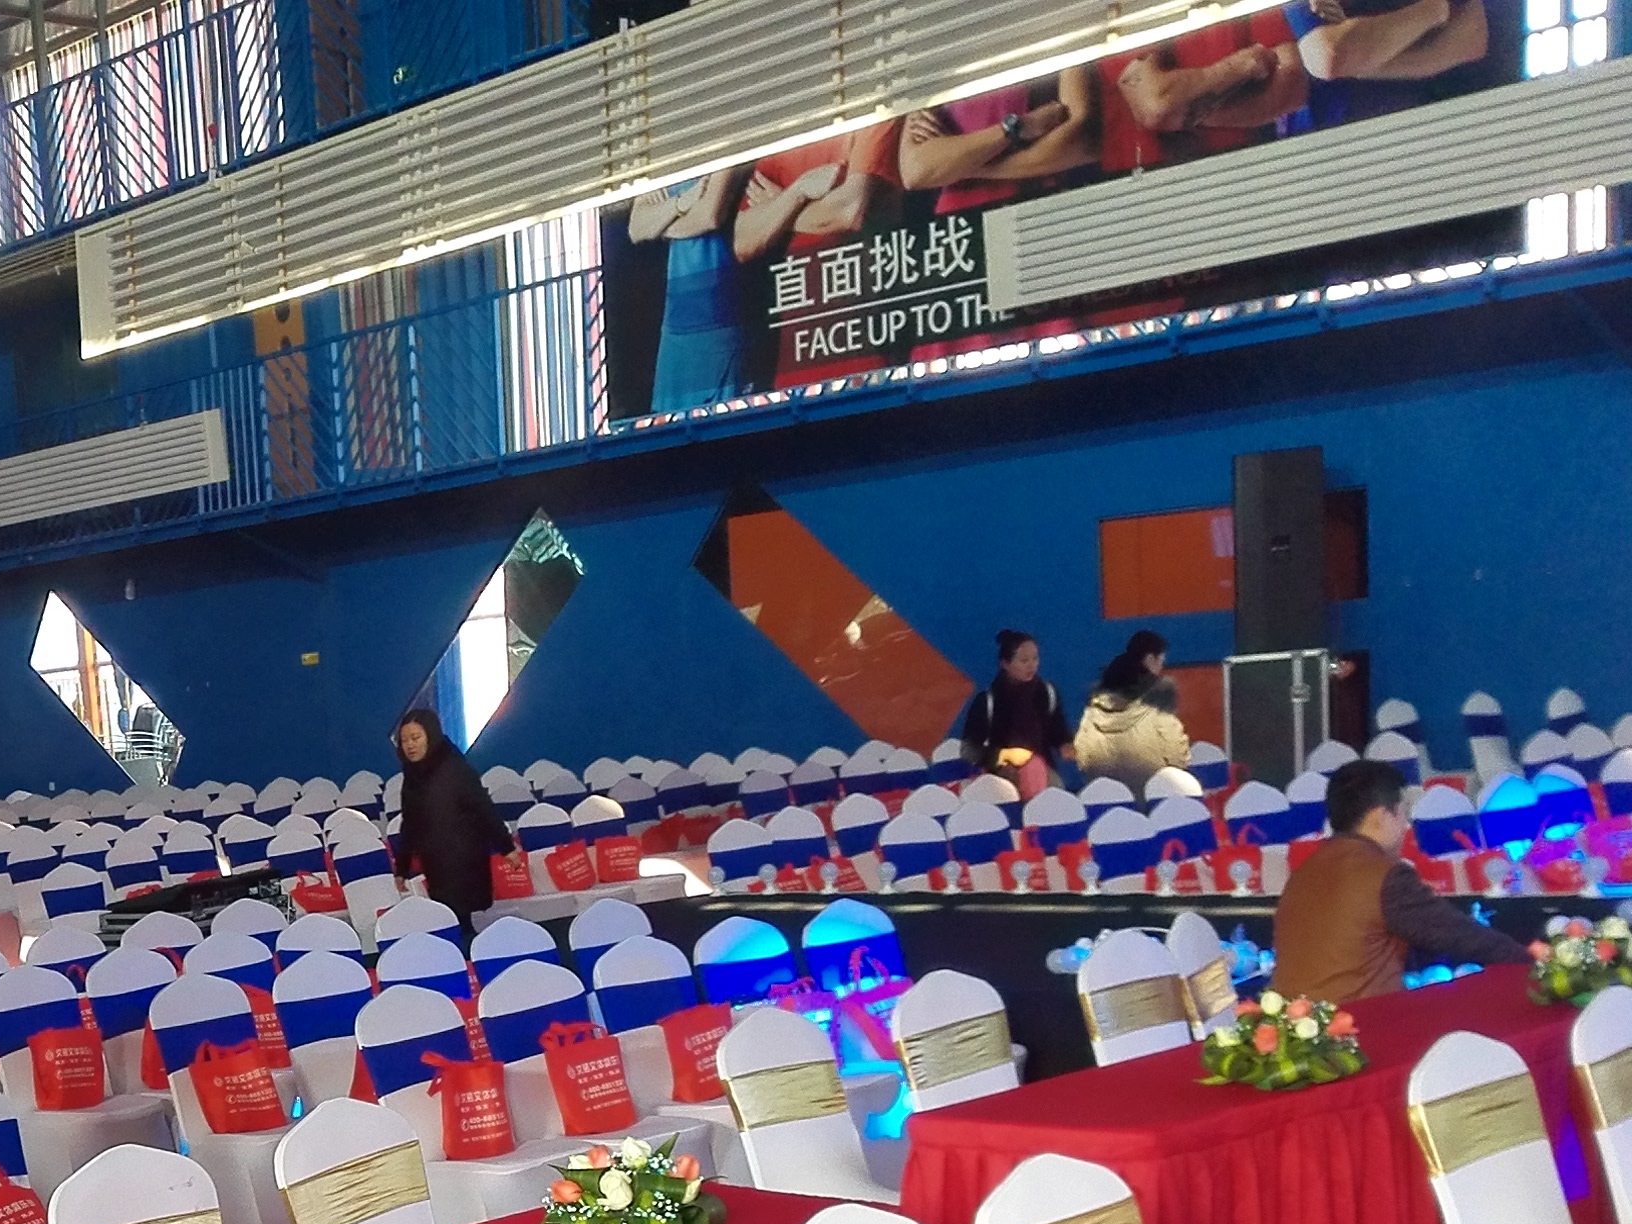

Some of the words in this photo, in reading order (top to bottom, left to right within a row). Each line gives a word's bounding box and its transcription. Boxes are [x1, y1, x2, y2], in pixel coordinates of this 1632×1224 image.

[768, 214, 976, 315] 直面挑战
[795, 318, 864, 361] FACE
[868, 309, 906, 347] UP
[909, 299, 952, 337] TO
